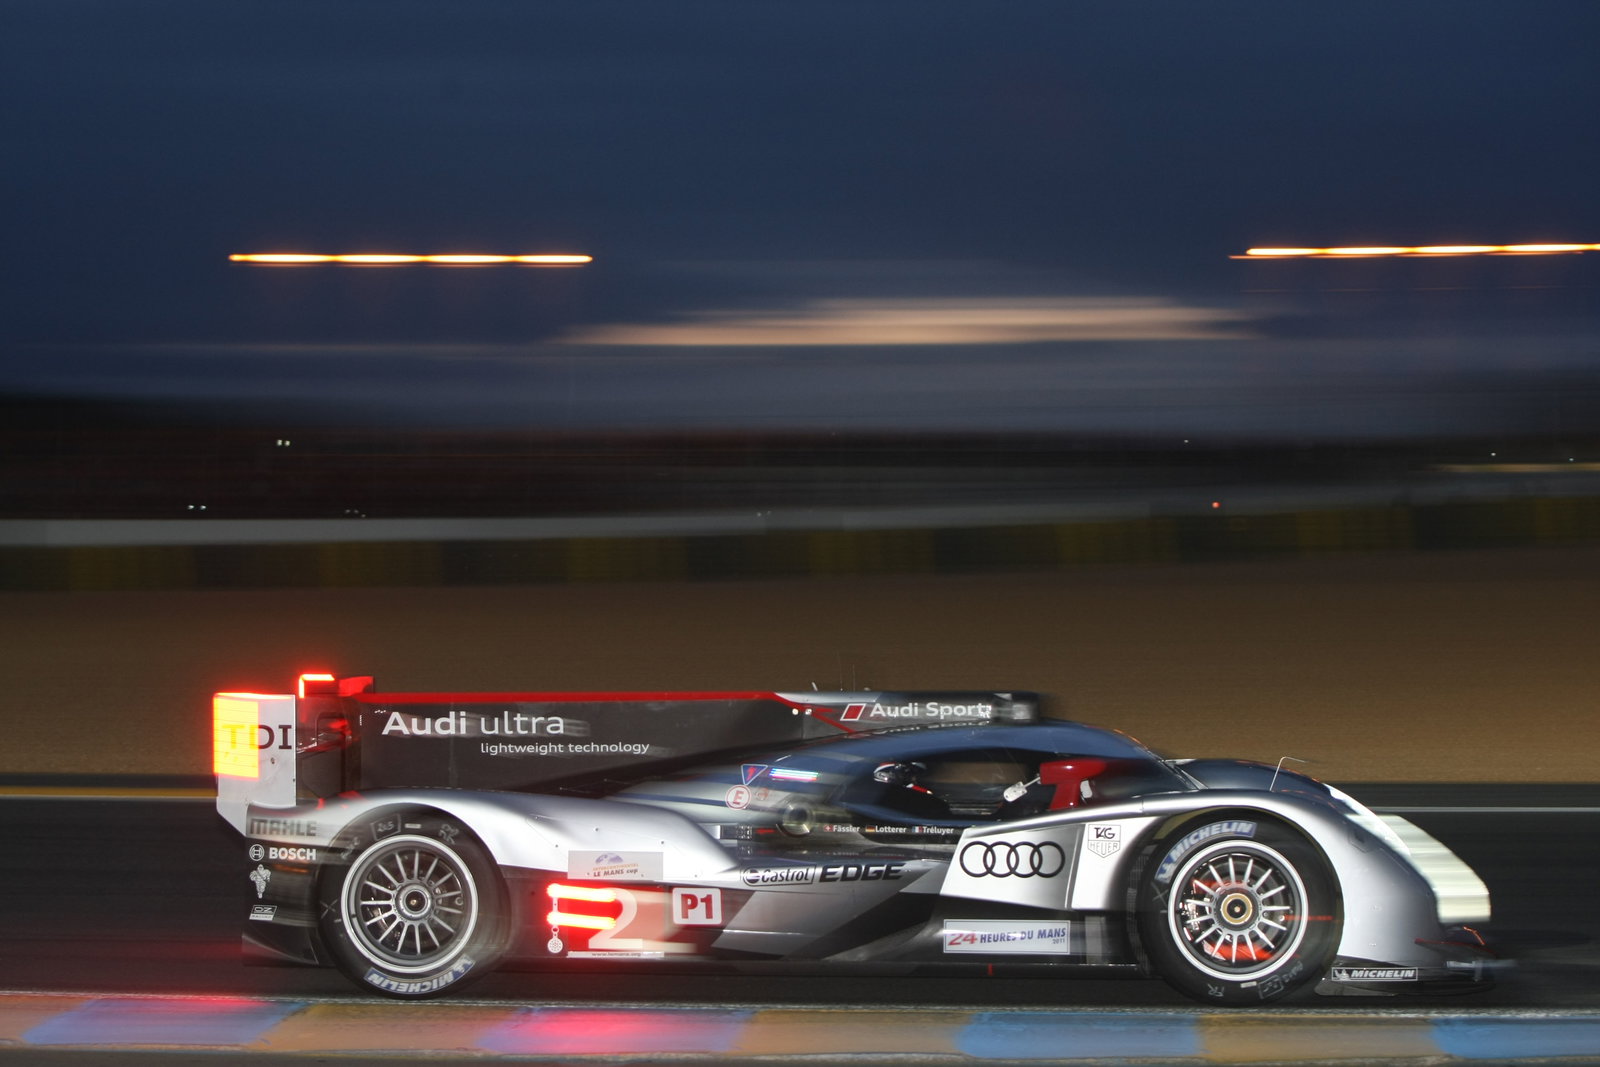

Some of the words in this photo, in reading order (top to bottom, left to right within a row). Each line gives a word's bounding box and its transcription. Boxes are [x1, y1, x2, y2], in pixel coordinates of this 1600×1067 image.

[870, 703, 918, 717] Audi
[926, 702, 989, 719] Sport
[381, 711, 466, 735] Audi
[480, 711, 565, 735] ultra
[222, 725, 292, 749] TDI
[481, 743, 564, 756] lightweight
[568, 742, 650, 755] technology
[732, 790, 744, 805] E
[250, 818, 317, 836] MAHLE
[832, 824, 860, 833] Fässler
[875, 825, 907, 834] Lotterer
[922, 826, 954, 836] Tréluyer
[1094, 827, 1115, 840] TAG
[1089, 842, 1119, 856] HEUER
[1171, 821, 1253, 860] MICHELIN
[269, 847, 317, 860] BOSCH
[761, 867, 810, 884] Castrol
[819, 863, 906, 882] EDGE
[680, 893, 714, 919] P1
[588, 887, 643, 949] 2
[948, 932, 977, 946] 24
[1020, 930, 1034, 940] DU
[1037, 927, 1066, 939] MANS
[368, 971, 454, 992] MICHELIN
[1350, 969, 1415, 978] MICHELIN
